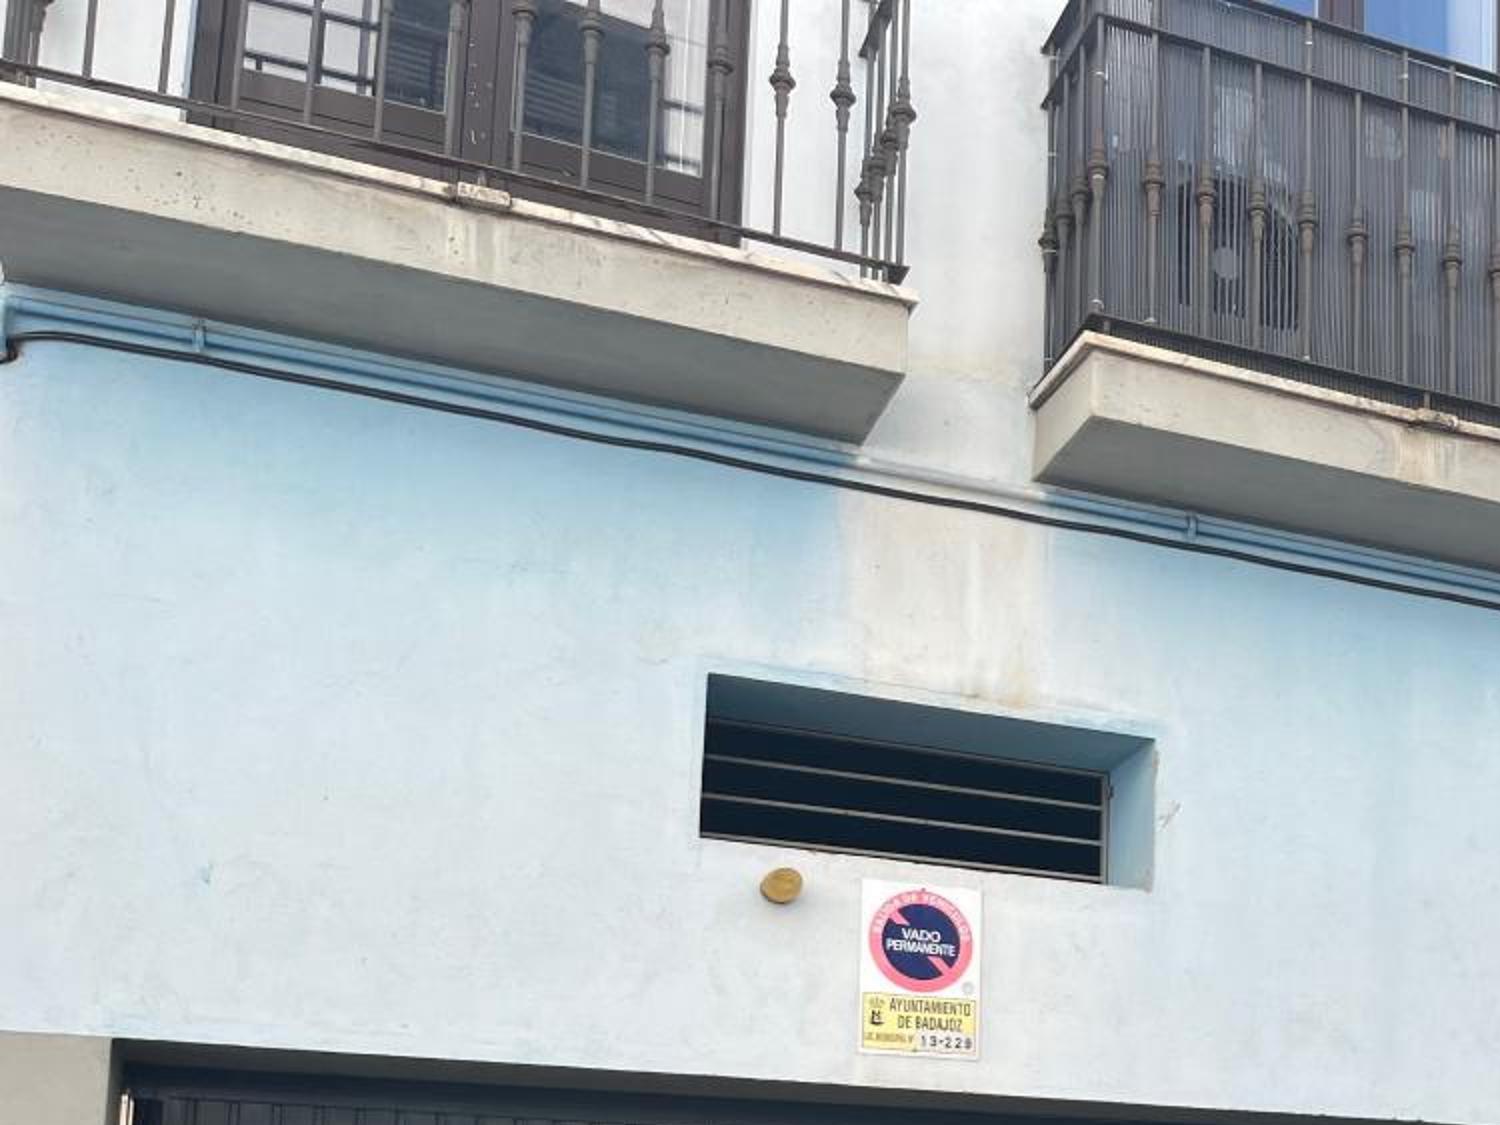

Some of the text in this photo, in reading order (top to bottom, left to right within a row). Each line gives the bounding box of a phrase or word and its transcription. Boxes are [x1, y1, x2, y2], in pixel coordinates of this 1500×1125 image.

[901, 927, 941, 943] VADO
[886, 938, 956, 957] PERMANENTE
[889, 998, 971, 1017] AYUNTAMIENTO
[897, 1015, 962, 1032] DE BADAJOZ
